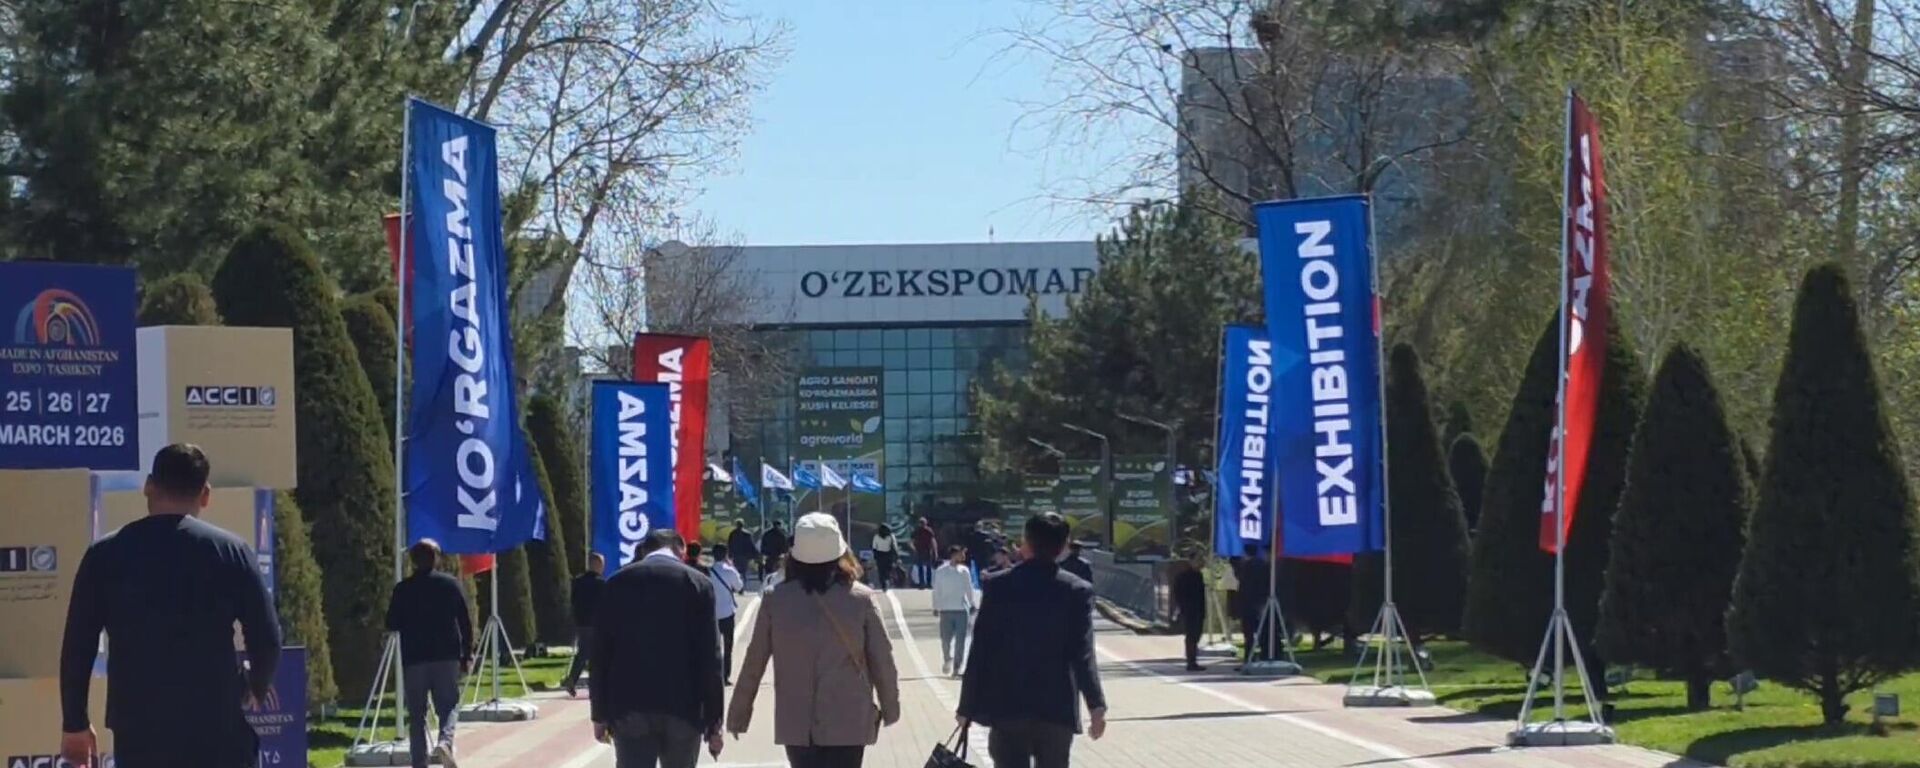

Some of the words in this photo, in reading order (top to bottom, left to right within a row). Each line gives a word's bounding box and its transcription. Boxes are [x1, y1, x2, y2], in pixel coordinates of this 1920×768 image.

[440, 134, 497, 532] KO‘RGAZMA
[43, 349, 119, 362] AFGHANISTAN
[12, 362, 42, 374] EXPO
[47, 363, 103, 376] TASHKENT
[1293, 219, 1358, 527] EXHIBITION
[799, 375, 830, 386] AGRO
[6, 391, 32, 412] 25
[48, 392, 73, 412] 26
[86, 393, 111, 413] 27
[187, 387, 253, 404] ACCI
[0, 424, 70, 446] MARCH
[75, 425, 125, 446] 2026
[800, 433, 864, 447] agroworld
